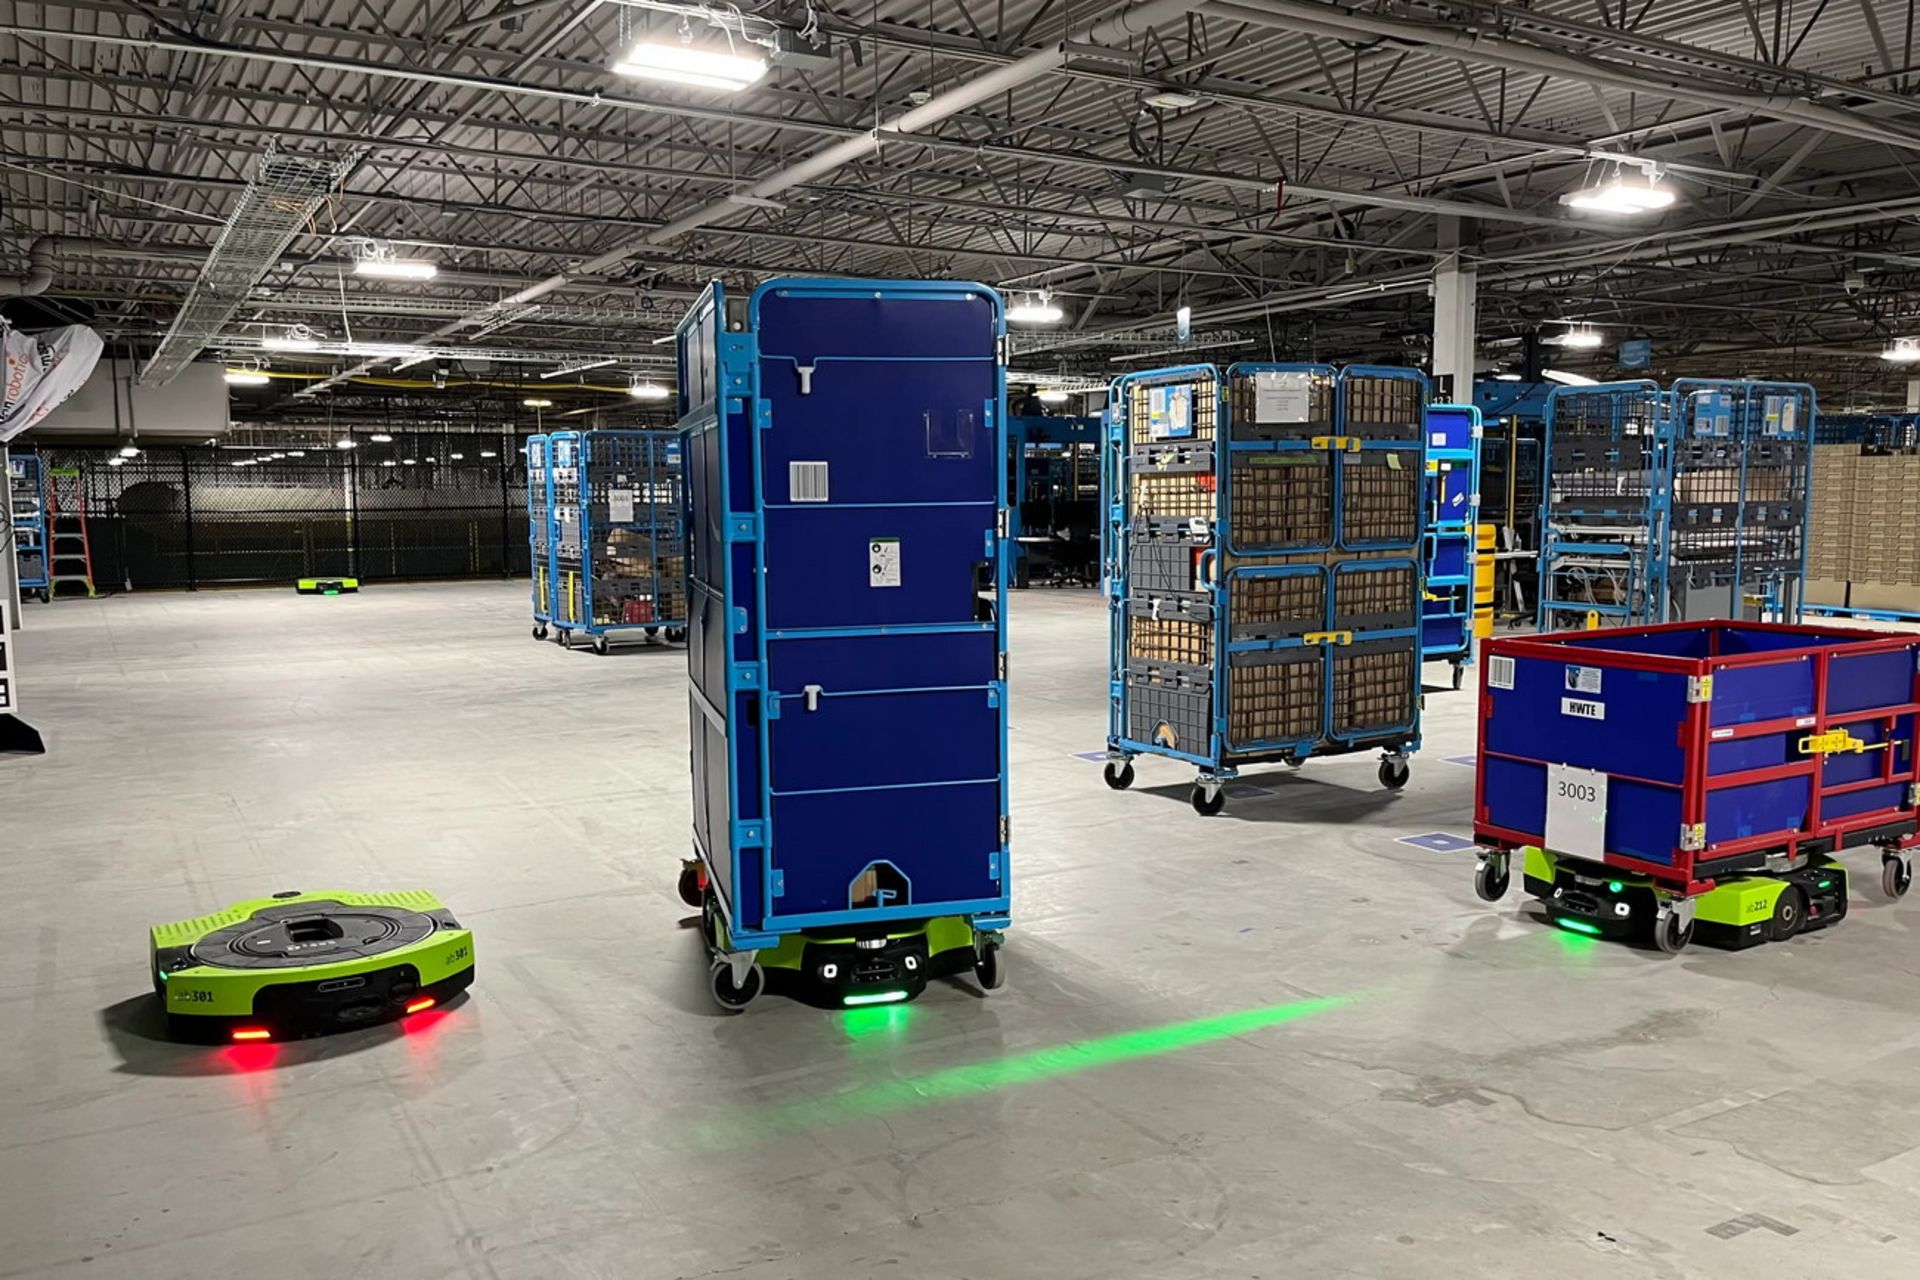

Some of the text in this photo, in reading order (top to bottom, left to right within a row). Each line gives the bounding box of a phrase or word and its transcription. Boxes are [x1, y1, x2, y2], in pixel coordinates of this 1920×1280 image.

[1439, 376, 1447, 393] L
[1569, 701, 1596, 716] HWTE
[1558, 781, 1596, 802] 3003
